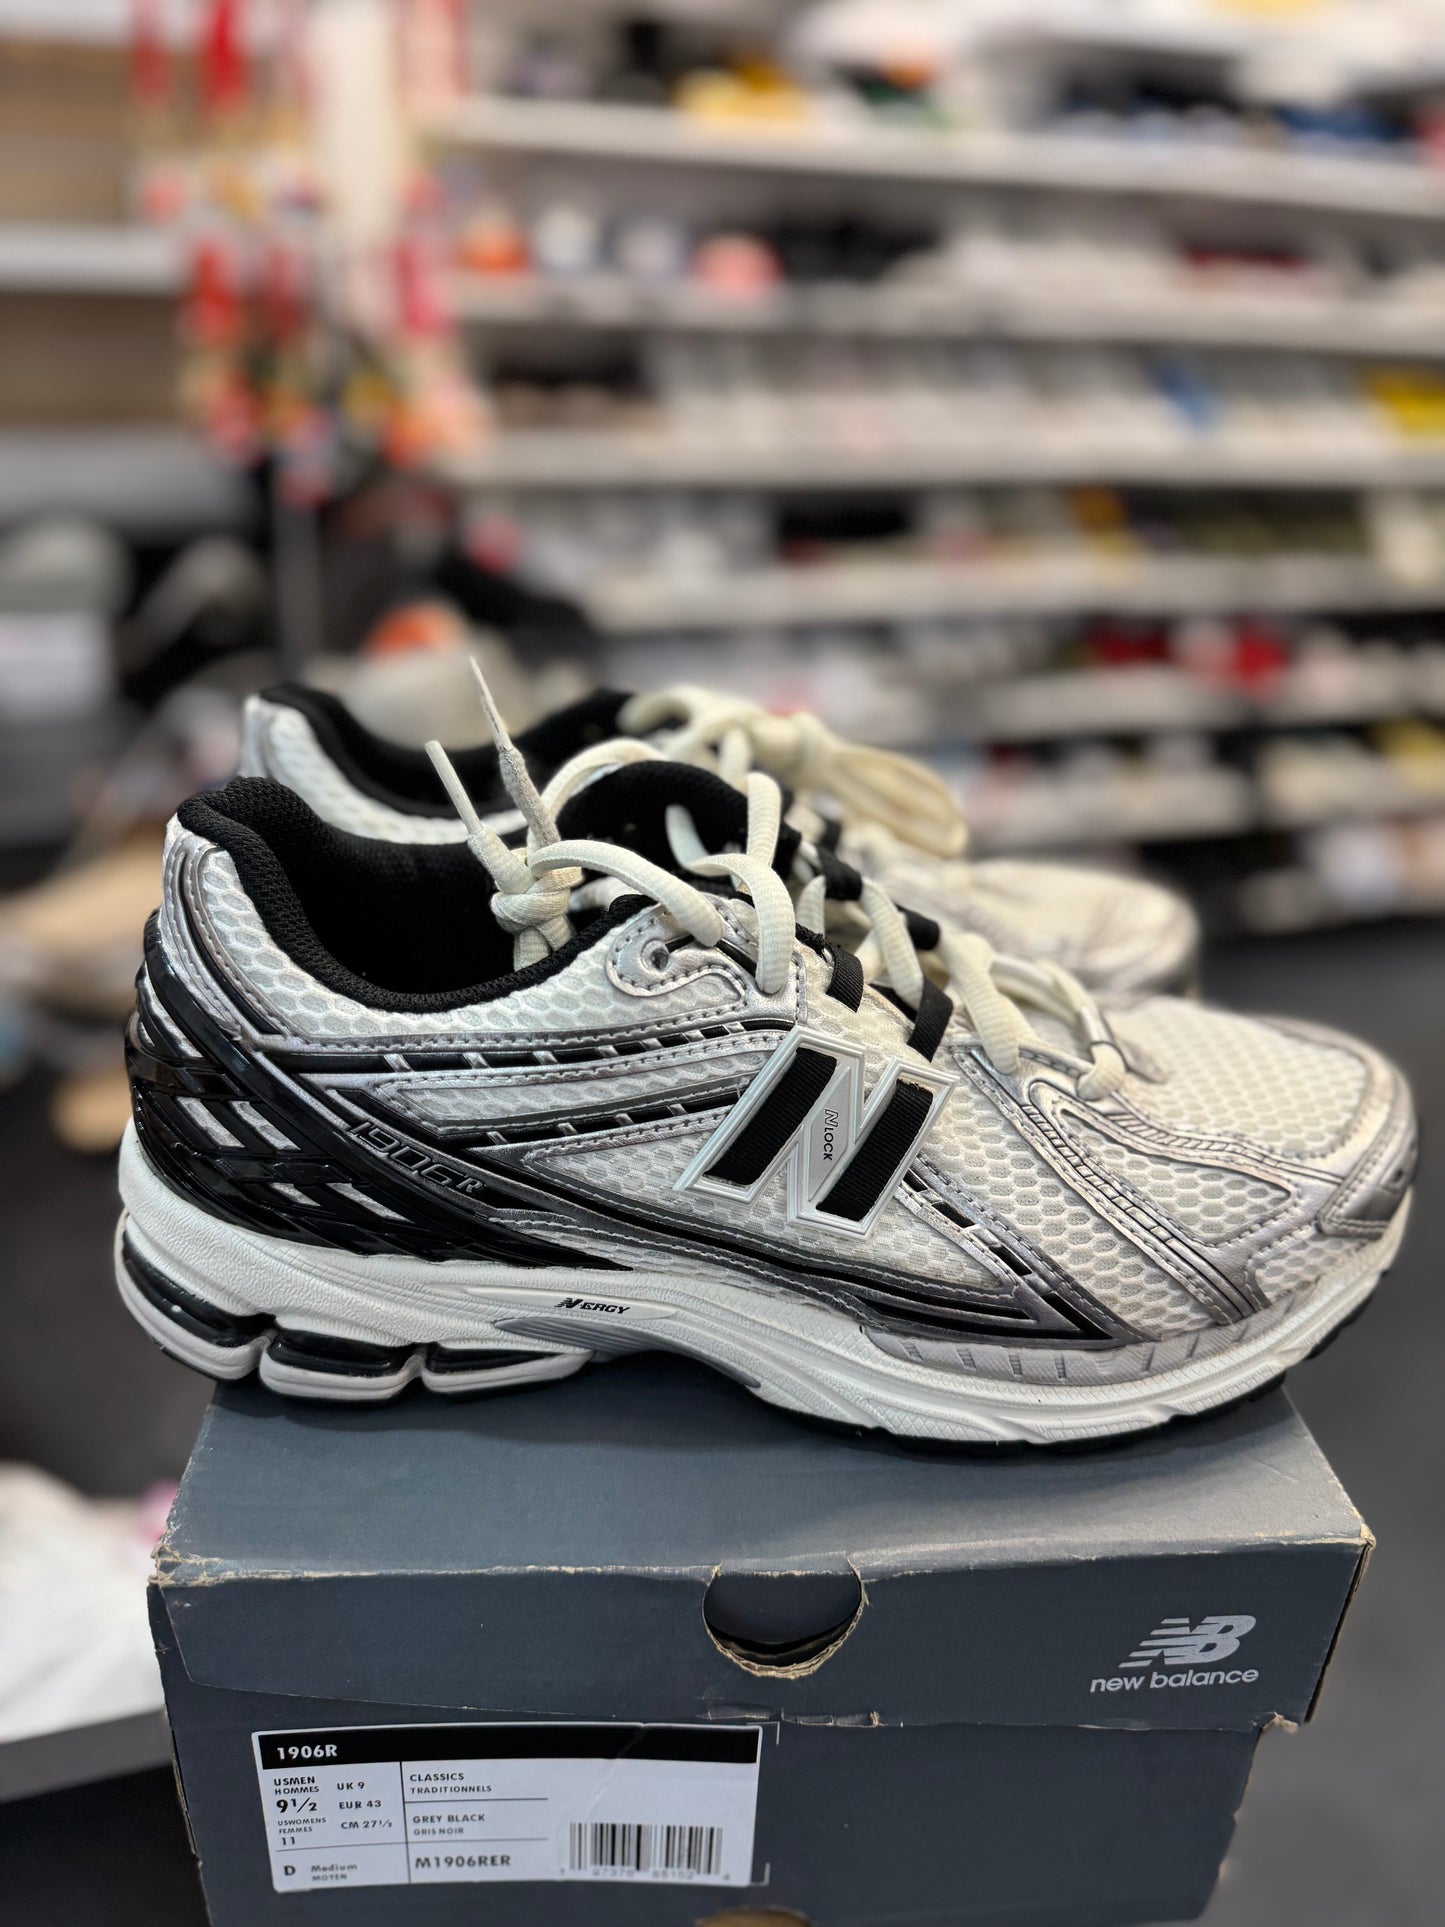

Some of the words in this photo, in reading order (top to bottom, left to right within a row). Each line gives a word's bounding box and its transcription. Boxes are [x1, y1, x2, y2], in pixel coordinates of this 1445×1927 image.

[1090, 1675, 1145, 1693] new
[1150, 1669, 1259, 1689] balance
[277, 1744, 338, 1760] 1906R
[273, 1775, 316, 1787] USMEN
[409, 1772, 465, 1782] CLASSICS
[274, 1785, 320, 1796] HOMMES
[336, 1782, 354, 1791] UK
[357, 1781, 365, 1790] 9
[410, 1785, 493, 1795] TRADITIONNELS
[339, 1801, 362, 1810] EUR
[366, 1799, 382, 1809] 43
[277, 1817, 327, 1827] USWOMENS
[413, 1815, 442, 1824] GREY
[447, 1813, 486, 1823] BLACK
[278, 1826, 313, 1835] FEMMES
[340, 1821, 359, 1830] CM
[440, 1827, 464, 1836] NOIR
[281, 1836, 296, 1846] 11
[415, 1855, 511, 1870] M1906RER
[284, 1865, 296, 1877] D
[310, 1863, 358, 1873] Medium
[312, 1874, 348, 1882] MOYEN
